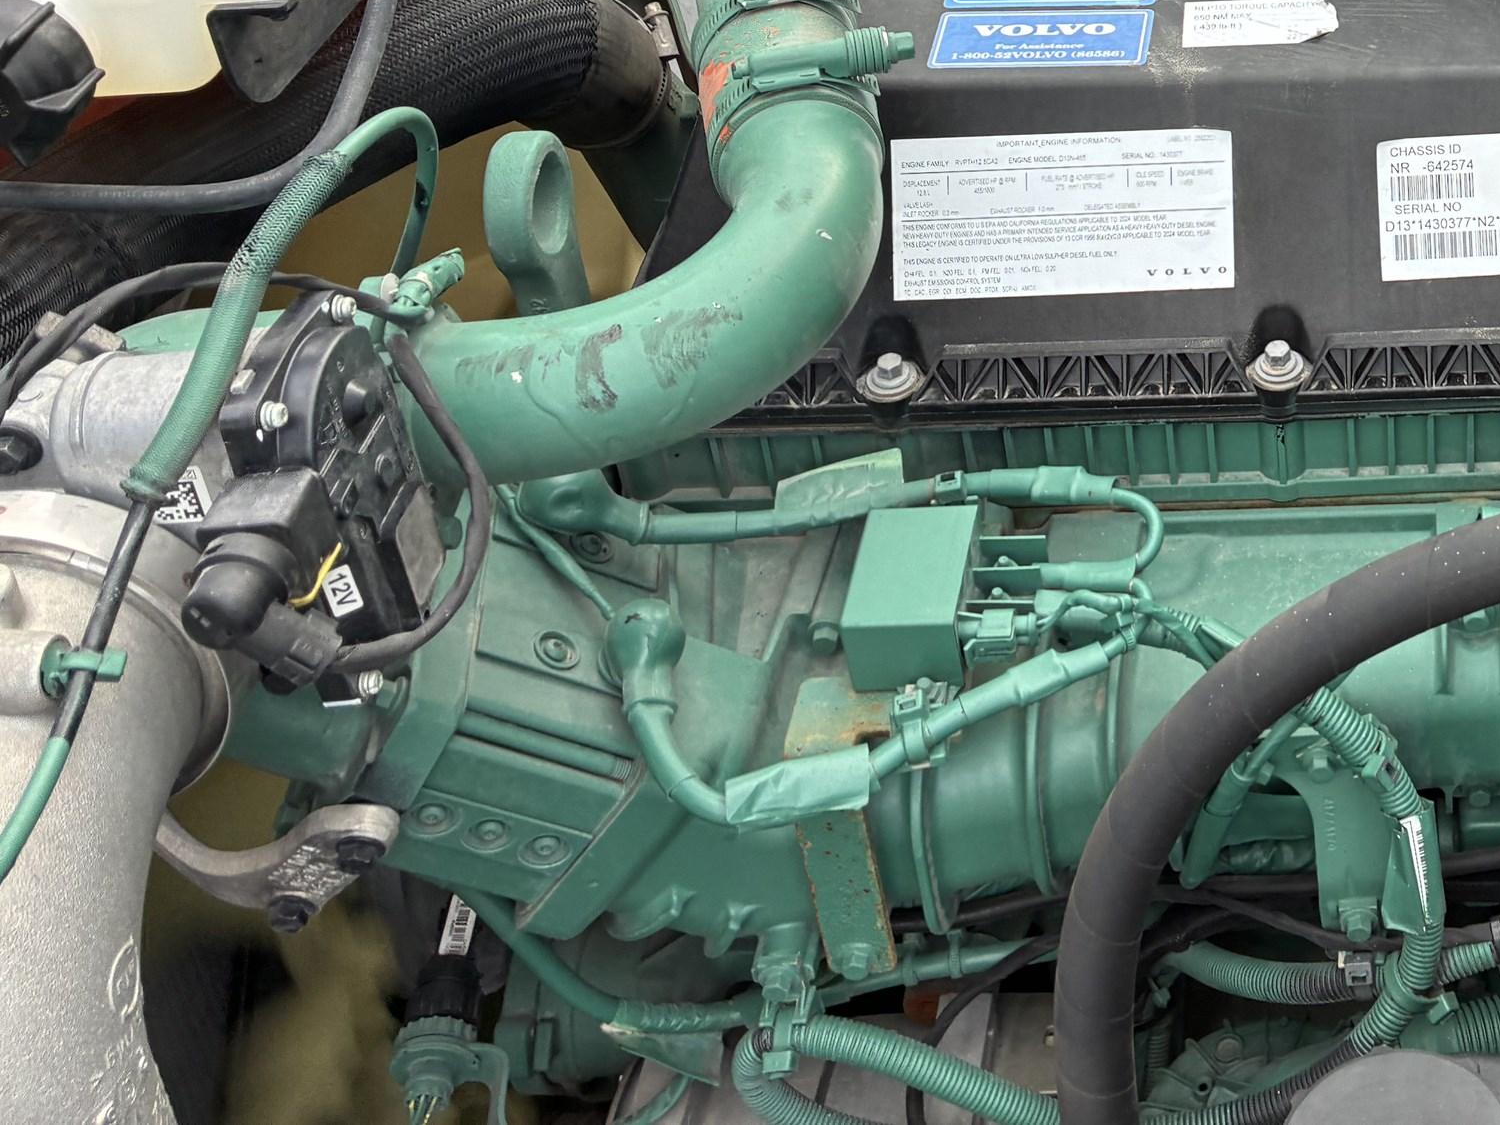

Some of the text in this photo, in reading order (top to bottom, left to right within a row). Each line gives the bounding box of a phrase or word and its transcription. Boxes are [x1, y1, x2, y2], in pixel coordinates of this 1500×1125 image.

[973, 22, 1116, 37] VOLVO
[995, 42, 1085, 50] For Assistance
[996, 136, 1120, 147] IMPORTANT ENGINE INFORMATION
[1390, 144, 1461, 157] CHASSIS ID
[900, 160, 925, 168] ENGINE
[1008, 156, 1032, 164] ENGINE
[1390, 159, 1474, 174] NR -642574
[902, 178, 941, 187] DISPLACEMENT
[1394, 202, 1462, 215] SERIAL NO
[935, 221, 966, 229] CONFORMS
[1008, 218, 1039, 226] CALIFORNIA
[1039, 217, 1077, 225] REGULATIONS
[1078, 215, 1108, 223] APPLICABLE
[973, 229, 985, 237] AND
[1077, 224, 1111, 232] APPLICATION
[915, 240, 936, 248] LEGACY
[937, 239, 957, 247] ENGINE
[1011, 236, 1022, 244] THE
[1022, 235, 1055, 243] PROVISIONS
[1122, 231, 1153, 239] APPLICABLE
[978, 254, 1002, 262] OPERATE
[1013, 253, 1030, 261] ULTRA
[1146, 265, 1227, 276] VOLVO
[328, 573, 358, 606] 12V
